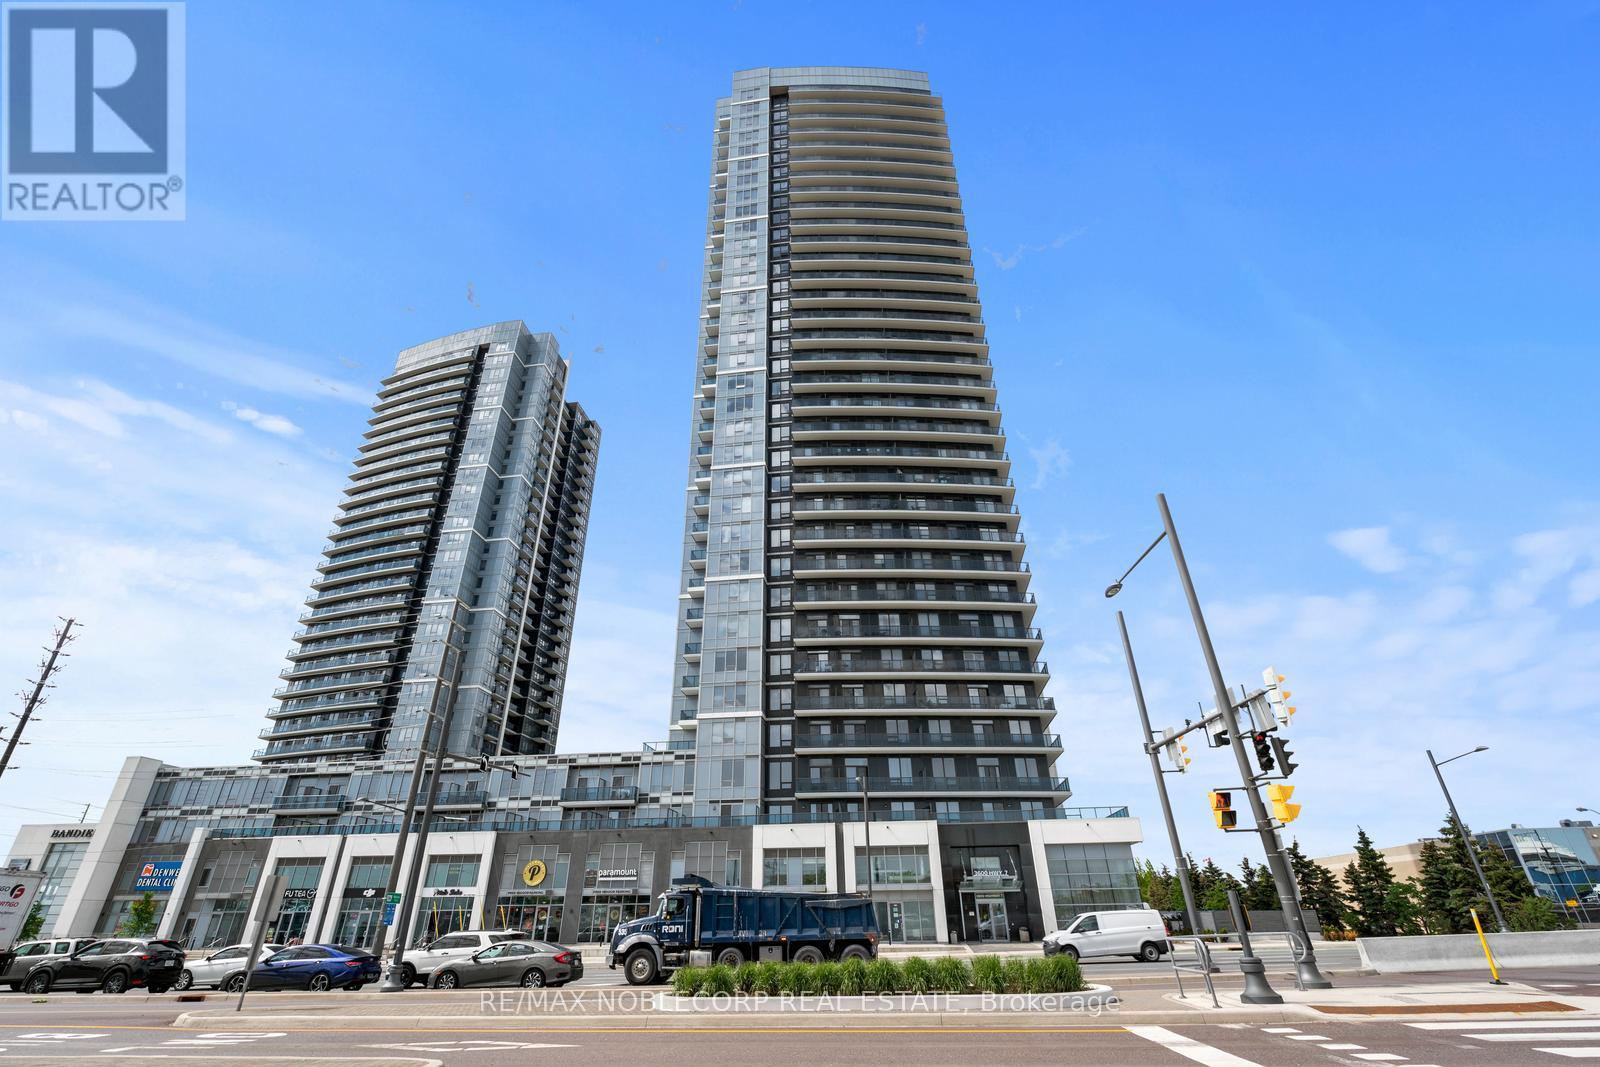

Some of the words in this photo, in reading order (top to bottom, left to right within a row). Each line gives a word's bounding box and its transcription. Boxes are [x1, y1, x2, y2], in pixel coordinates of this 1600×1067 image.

[153, 868, 181, 877] DENWE
[598, 868, 637, 877] paramount
[136, 878, 161, 887] DENTAL
[662, 925, 684, 933] RONI
